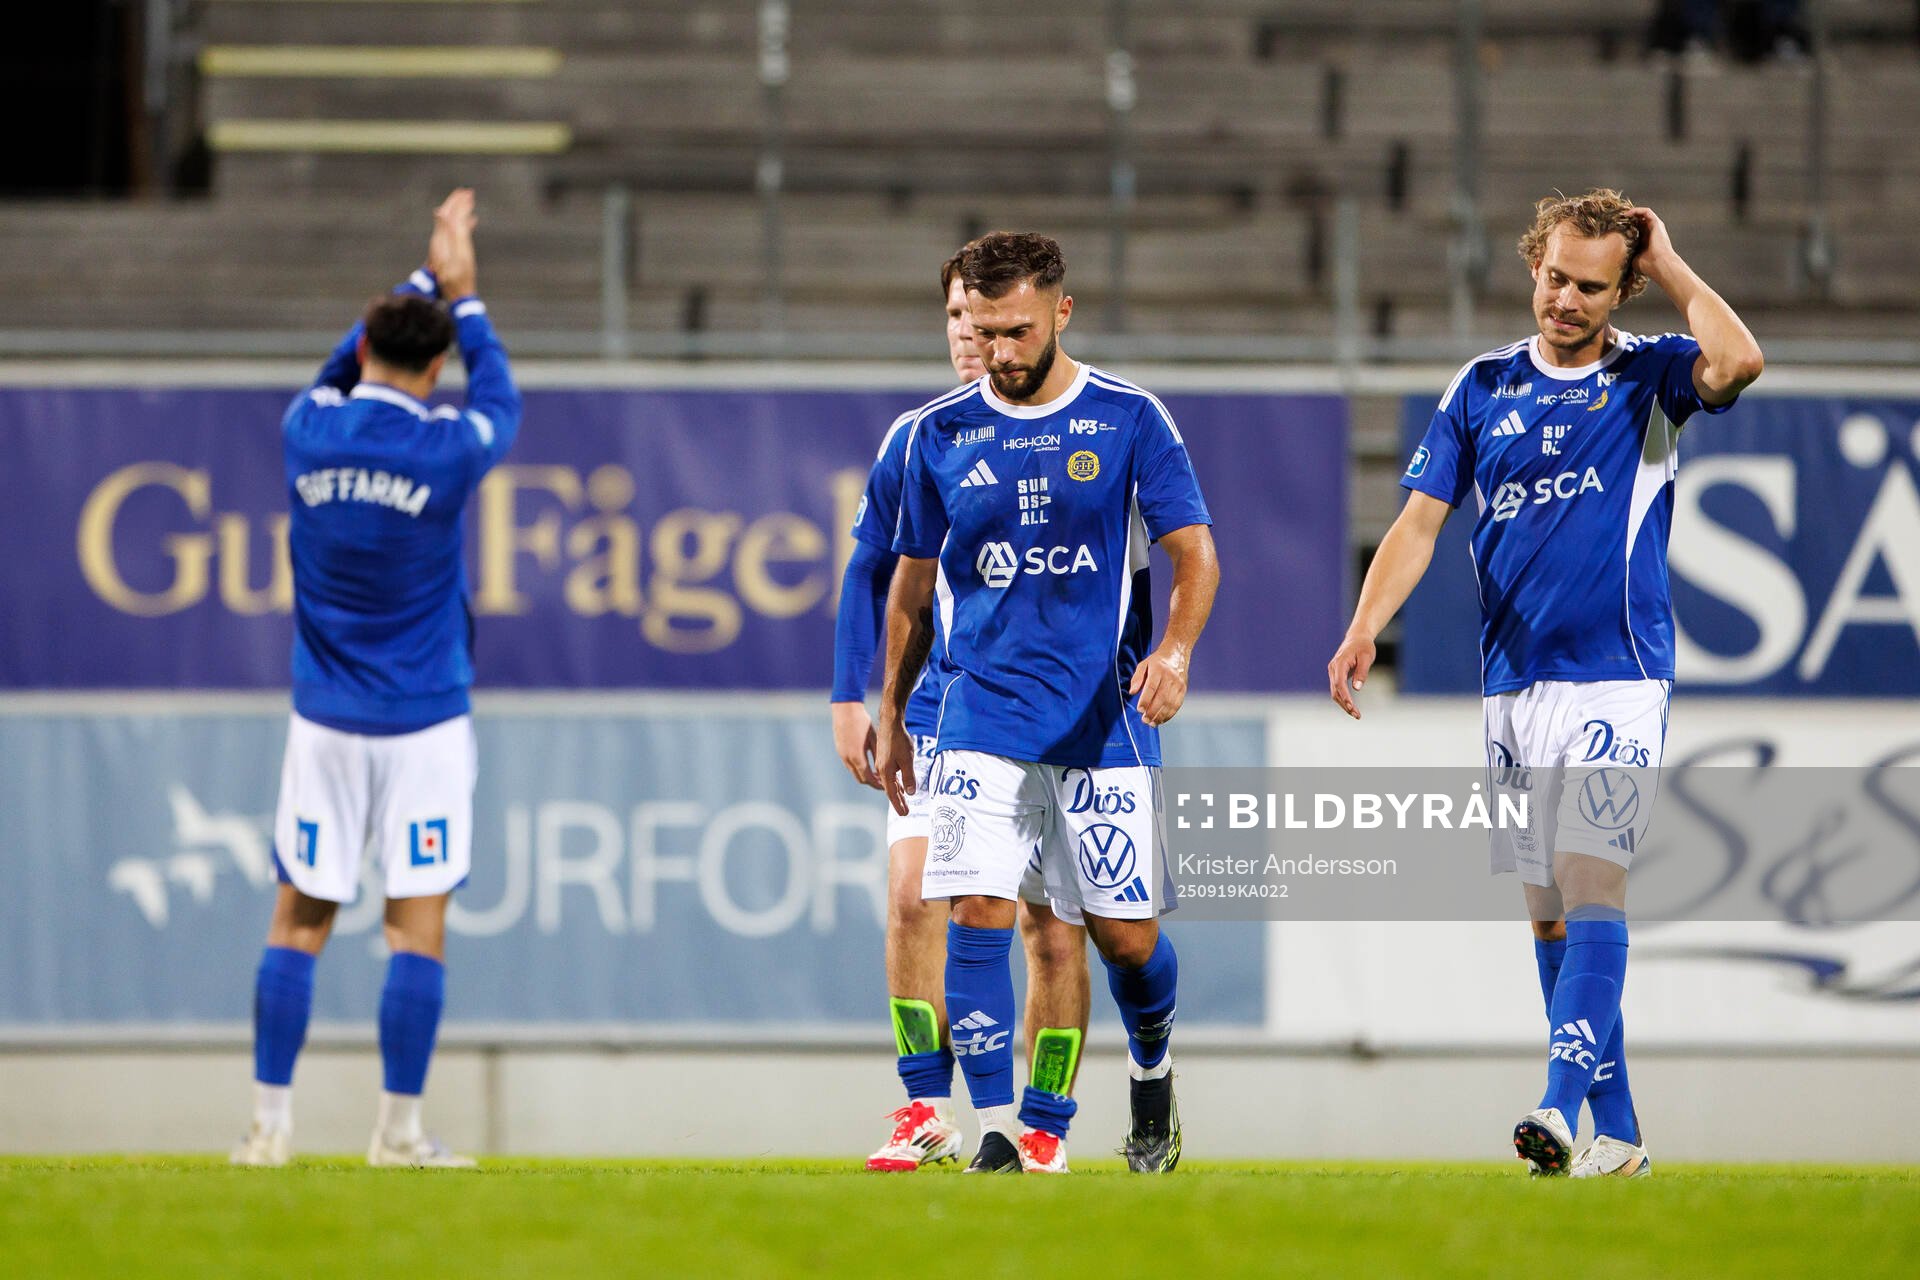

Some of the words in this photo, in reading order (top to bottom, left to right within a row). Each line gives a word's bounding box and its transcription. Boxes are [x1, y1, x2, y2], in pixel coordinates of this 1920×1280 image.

[1597, 372, 1621, 388] NP
[965, 426, 995, 442] LILIUM
[1069, 419, 1098, 435] NP3
[1543, 425, 1572, 439] SU
[1003, 435, 1060, 450] HIGHCON
[1018, 477, 1048, 494] SUN
[1533, 467, 1604, 504] SCA
[1020, 510, 1048, 526] ALL
[77, 462, 292, 617] Gu
[1023, 544, 1098, 575] SCA
[1581, 719, 1650, 768] Diös
[1493, 740, 1534, 791] Diö
[1062, 766, 1136, 815] Diös
[952, 1030, 1010, 1056] stc
